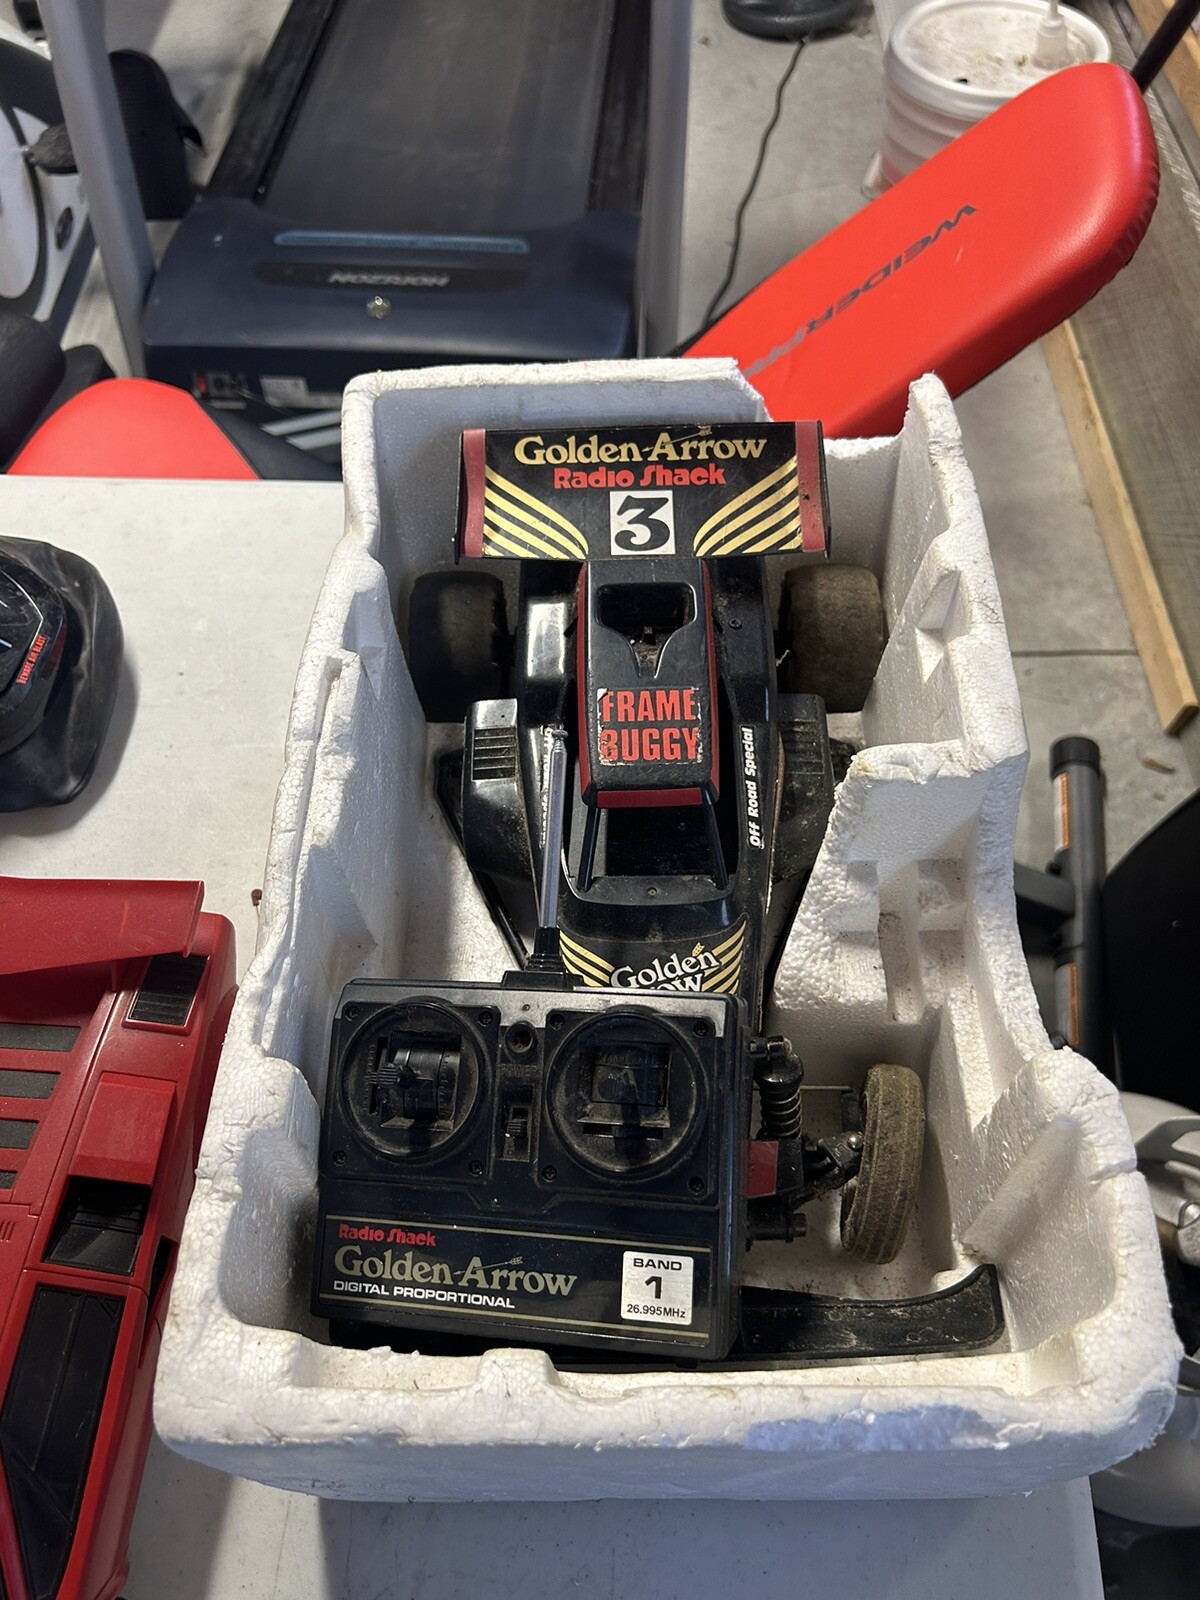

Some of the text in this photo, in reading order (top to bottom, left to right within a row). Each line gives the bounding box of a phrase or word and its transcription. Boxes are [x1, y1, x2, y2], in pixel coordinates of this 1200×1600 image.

[806, 204, 977, 335] WEIDER
[514, 432, 768, 466] Golden Arrow
[554, 463, 726, 489] Radio Shack
[614, 495, 671, 552] 3
[602, 689, 698, 722] FRAME
[600, 727, 700, 761] BUGGY
[741, 727, 764, 848] Off Road Special
[610, 951, 720, 989] Golden
[339, 1224, 436, 1247] Radio Shack
[334, 1245, 577, 1296] Golden Arrow
[633, 1258, 682, 1271] BAND
[333, 1280, 515, 1308] DIGITAL PROPORTIONAL
[644, 1276, 663, 1299] 1
[626, 1303, 687, 1318] 26.995MHz
